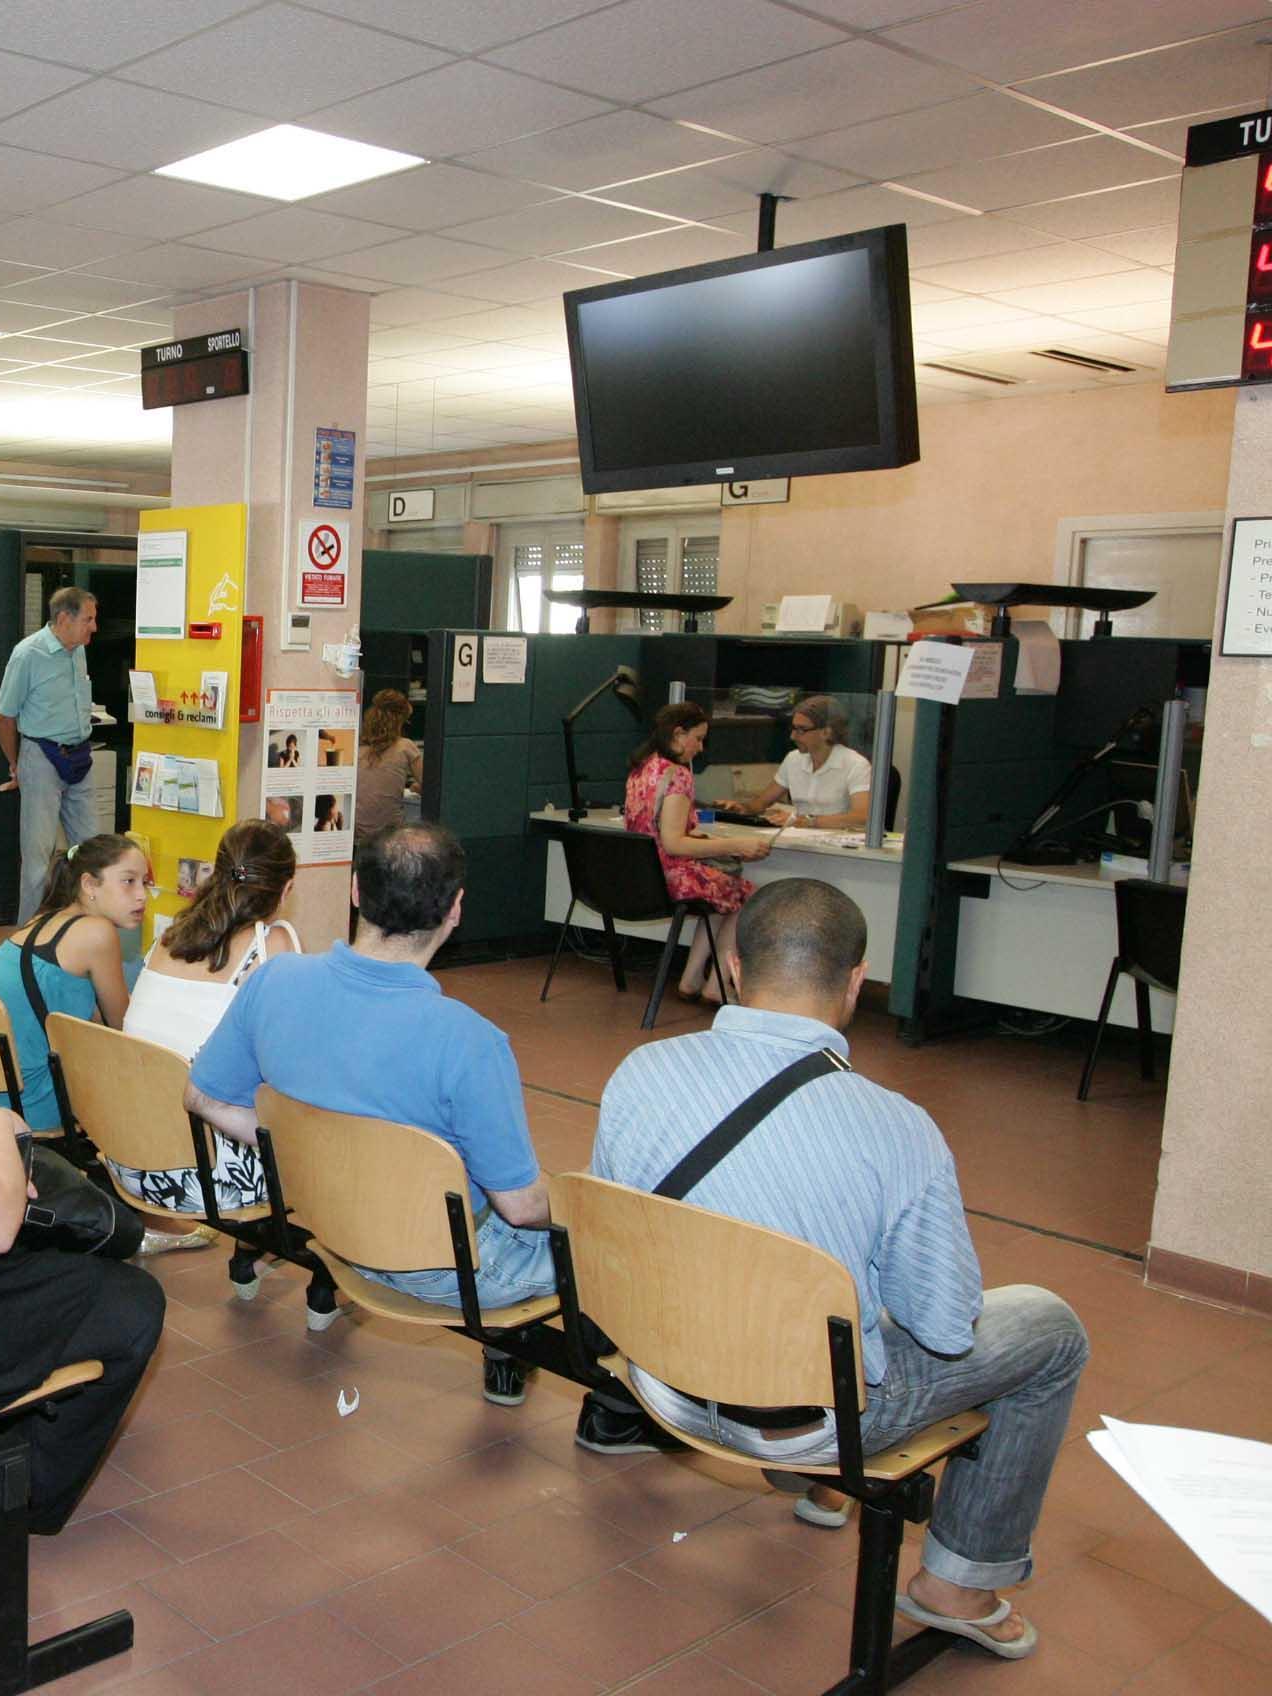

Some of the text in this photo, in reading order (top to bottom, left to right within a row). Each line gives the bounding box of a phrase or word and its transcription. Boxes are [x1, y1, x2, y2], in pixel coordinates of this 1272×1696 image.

[208, 332, 240, 352] SPORTELLO
[156, 344, 183, 362] TURNO
[393, 497, 406, 517] D
[458, 643, 473, 667] G
[145, 708, 175, 723] consigli
[187, 712, 217, 724] reclami
